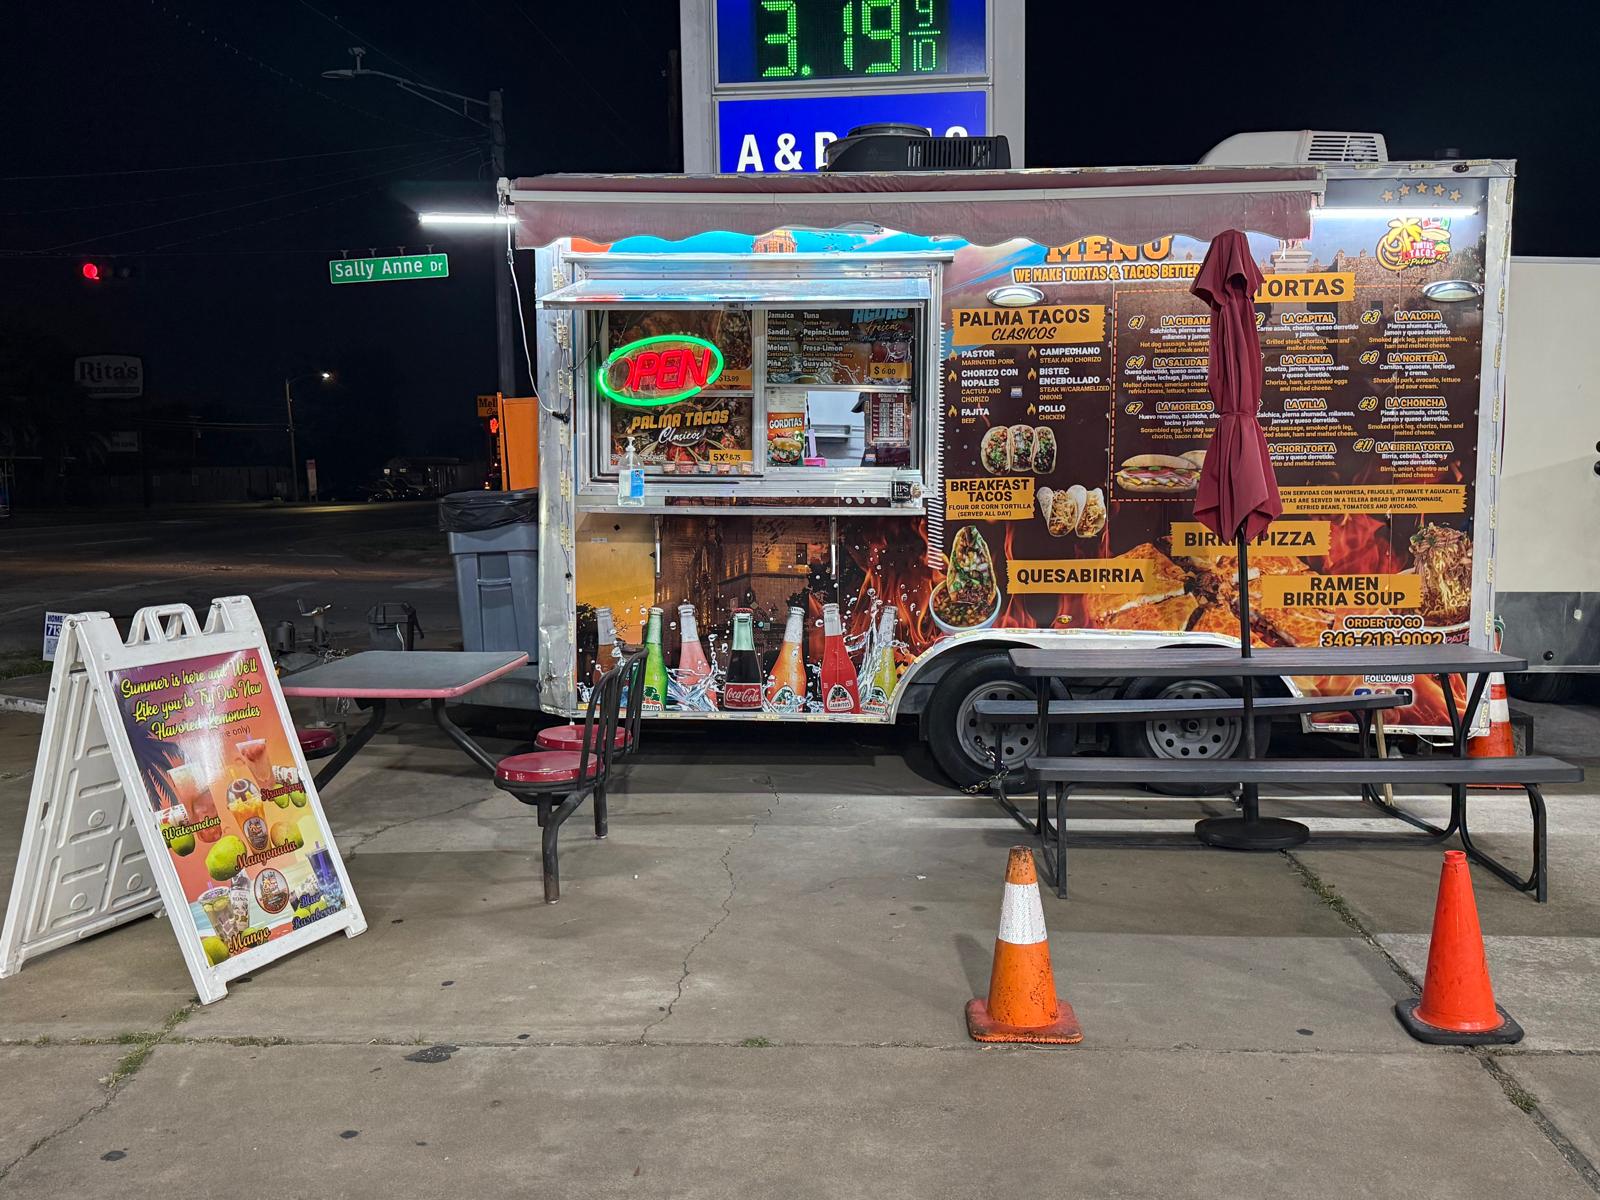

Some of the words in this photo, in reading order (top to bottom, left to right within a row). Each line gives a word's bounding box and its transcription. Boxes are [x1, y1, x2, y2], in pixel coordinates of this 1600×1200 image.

[737, 134, 764, 172] A
[773, 133, 803, 171] &
[1410, 249, 1436, 257] TACOS
[335, 262, 374, 279] Sally
[382, 260, 423, 275] Anne
[430, 261, 443, 272] Dr
[1015, 268, 1032, 283] WE
[1033, 267, 1062, 283] MAKE
[1064, 266, 1107, 282] TORTAS
[1109, 266, 1121, 281] &
[1123, 264, 1159, 280] TACOS
[1161, 263, 1201, 279] BETTER
[1256, 278, 1345, 297] TORTAS
[767, 311, 794, 319] Jamaica
[803, 311, 820, 319] Tuna
[960, 310, 1024, 326] PALMA
[1027, 308, 1090, 325] TACOS
[1162, 316, 1174, 326] LA
[1175, 315, 1211, 326] CUBANA
[1282, 315, 1295, 323] LA
[1296, 314, 1334, 323] CAPITAL
[1396, 312, 1408, 321] LA
[1410, 311, 1440, 320] ALOHA
[991, 327, 1057, 341] CLASICOS
[767, 344, 788, 352] Melon
[1040, 347, 1100, 356] CAMPECHANO
[961, 350, 995, 358] PASTOR
[1389, 355, 1400, 363] LA
[1402, 352, 1445, 362] NORTEÑA
[803, 360, 832, 368] Guayaba
[1282, 356, 1295, 365] LA
[1295, 355, 1331, 364] GRANJA
[79, 362, 138, 382] Rita's
[606, 348, 712, 392] OPEN
[961, 370, 999, 378] CHORIZO
[1001, 368, 1018, 376] CON
[1040, 367, 1069, 375] BISTEC
[961, 379, 999, 387] NOPALES
[1039, 376, 1100, 385] ENCEBOLLADO
[1039, 404, 1065, 412] POLLO
[1158, 403, 1169, 411] LA
[1171, 402, 1212, 411] MORELOS
[1286, 401, 1297, 409] LA
[1299, 400, 1326, 409] VILLA
[1387, 399, 1399, 407] LA
[1400, 398, 1445, 407] CHONCHA
[961, 408, 990, 416] FAJITA
[631, 414, 681, 431] PALMA
[685, 410, 730, 426] TACOS
[769, 417, 803, 429] GORDITAS
[658, 426, 702, 444] Clasicos
[1276, 445, 1304, 453] CHORI
[1304, 444, 1335, 452] TORTA
[1377, 443, 1390, 452] LA
[1391, 443, 1421, 451] BIRRIA
[1422, 442, 1452, 451] TORTA
[950, 479, 1029, 491] BREAKFAST
[967, 491, 1012, 502] TACOS
[1257, 531, 1316, 546] PIZZA
[1016, 568, 1144, 584] QUESABIRRIA
[1310, 576, 1379, 591] RAMEN
[1283, 592, 1347, 607] BIRRIA
[1353, 591, 1406, 606] SOUP
[1346, 618, 1384, 628] ORDER
[1388, 618, 1402, 627] TO
[1404, 618, 1421, 627] GO
[47, 624, 61, 636] 713
[1323, 632, 1444, 647] 346-218-9092
[120, 674, 170, 699] Summer
[171, 673, 181, 688] is
[182, 669, 206, 686] here
[207, 665, 228, 681] and
[228, 658, 258, 677] We'll
[1364, 674, 1399, 682] FOLLOW
[1400, 674, 1413, 682] US
[726, 687, 760, 703] Coca-Cola
[133, 700, 160, 723] Like
[161, 702, 183, 720] you
[183, 694, 195, 708] to
[195, 688, 216, 709] Try
[216, 684, 239, 703] Our
[239, 680, 262, 698] New
[151, 715, 206, 741] Flavored
[207, 703, 261, 730] Lemonades
[260, 782, 305, 802] Strawberry
[161, 815, 222, 839] Watermelon
[234, 839, 297, 871] Mangonada
[228, 926, 272, 954] Mango
